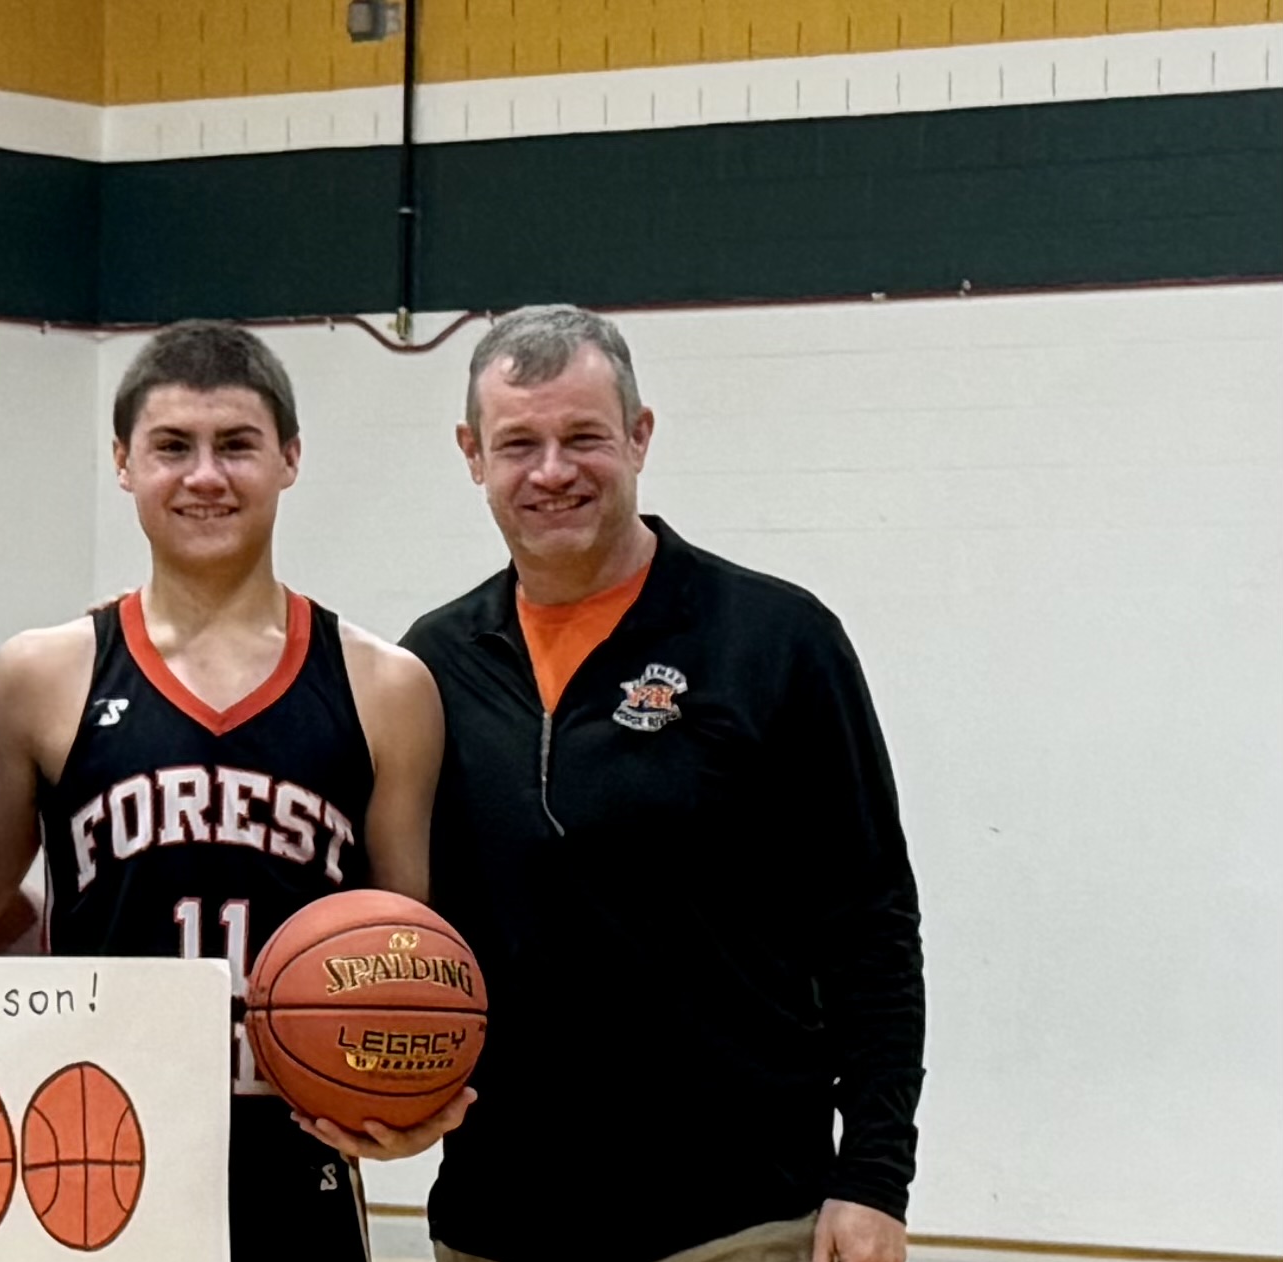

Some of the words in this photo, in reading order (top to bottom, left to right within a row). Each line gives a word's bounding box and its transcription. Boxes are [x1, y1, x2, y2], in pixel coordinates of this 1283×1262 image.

[70, 764, 356, 893] FOREST
[323, 953, 474, 998] SPALDING
[337, 1025, 467, 1056] LEGACY
